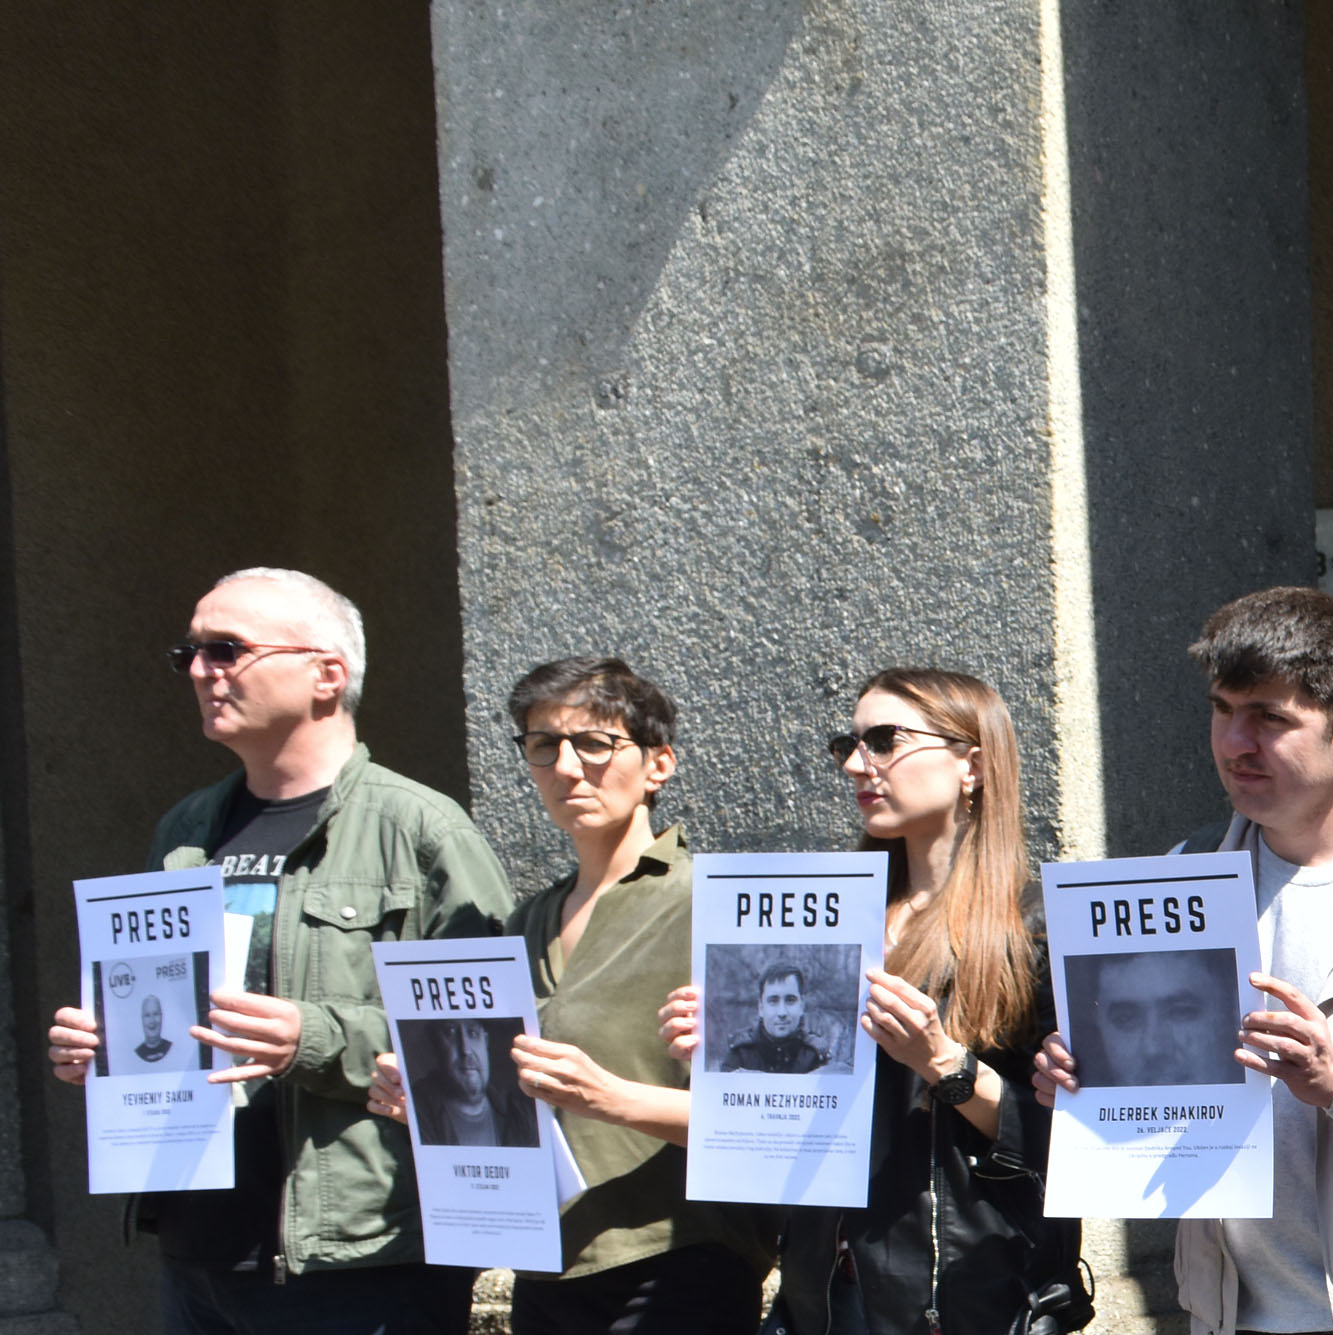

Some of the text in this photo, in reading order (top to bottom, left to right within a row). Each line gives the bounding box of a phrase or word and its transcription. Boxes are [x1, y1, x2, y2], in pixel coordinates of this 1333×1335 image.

[220, 854, 288, 877] BEAT
[737, 892, 839, 928] PRESS
[1090, 895, 1206, 937] PRESS
[111, 906, 190, 944] PRESS
[156, 963, 187, 979] PRESS
[410, 976, 494, 1011] PRESS
[123, 1090, 193, 1106] YEVHENIY SAKUN
[723, 1092, 838, 1109] ROMAN NEZHYBORETS
[1099, 1105, 1224, 1121] DILERBEK SHAKIROV
[453, 1165, 510, 1179] VIKTOR DEDOV
